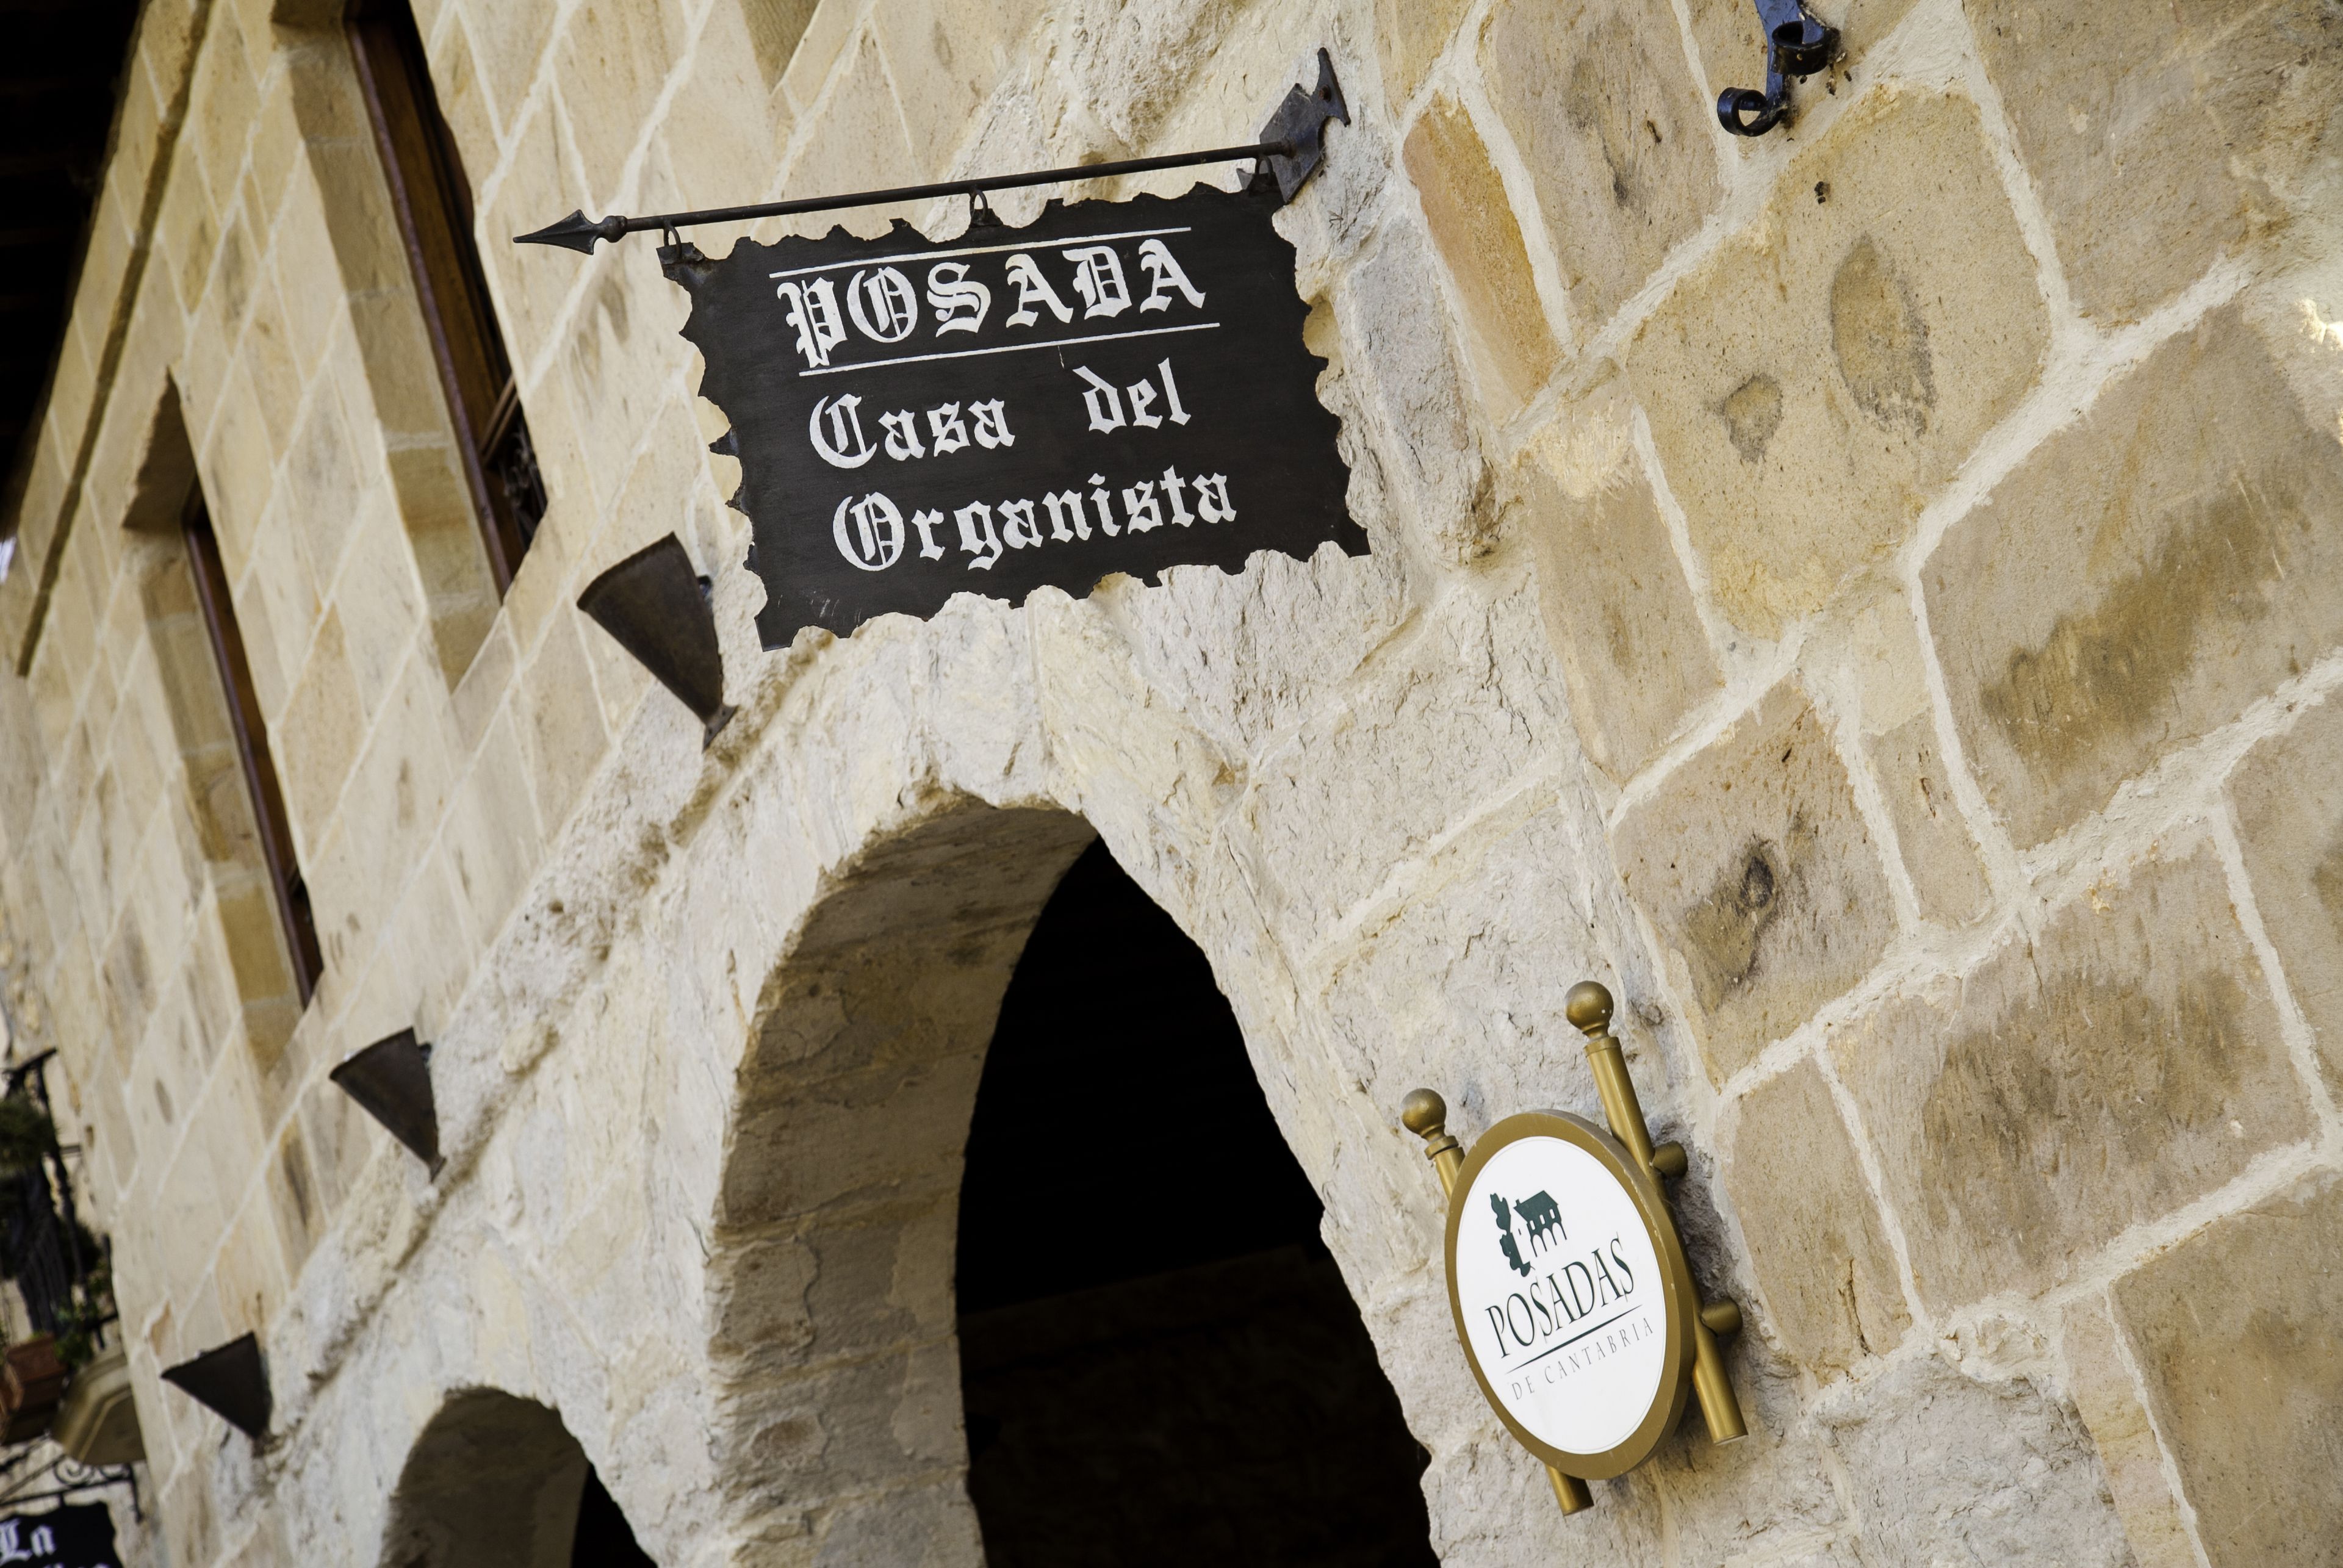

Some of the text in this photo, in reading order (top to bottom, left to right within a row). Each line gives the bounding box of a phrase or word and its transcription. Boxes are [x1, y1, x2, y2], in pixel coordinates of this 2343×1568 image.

[777, 239, 1206, 369] POSADA
[809, 357, 1192, 469] Casa del
[832, 465, 1237, 572] Organista
[1484, 1231, 1635, 1359] POSADAS
[1510, 1316, 1654, 1401] DE CANTABRIA
